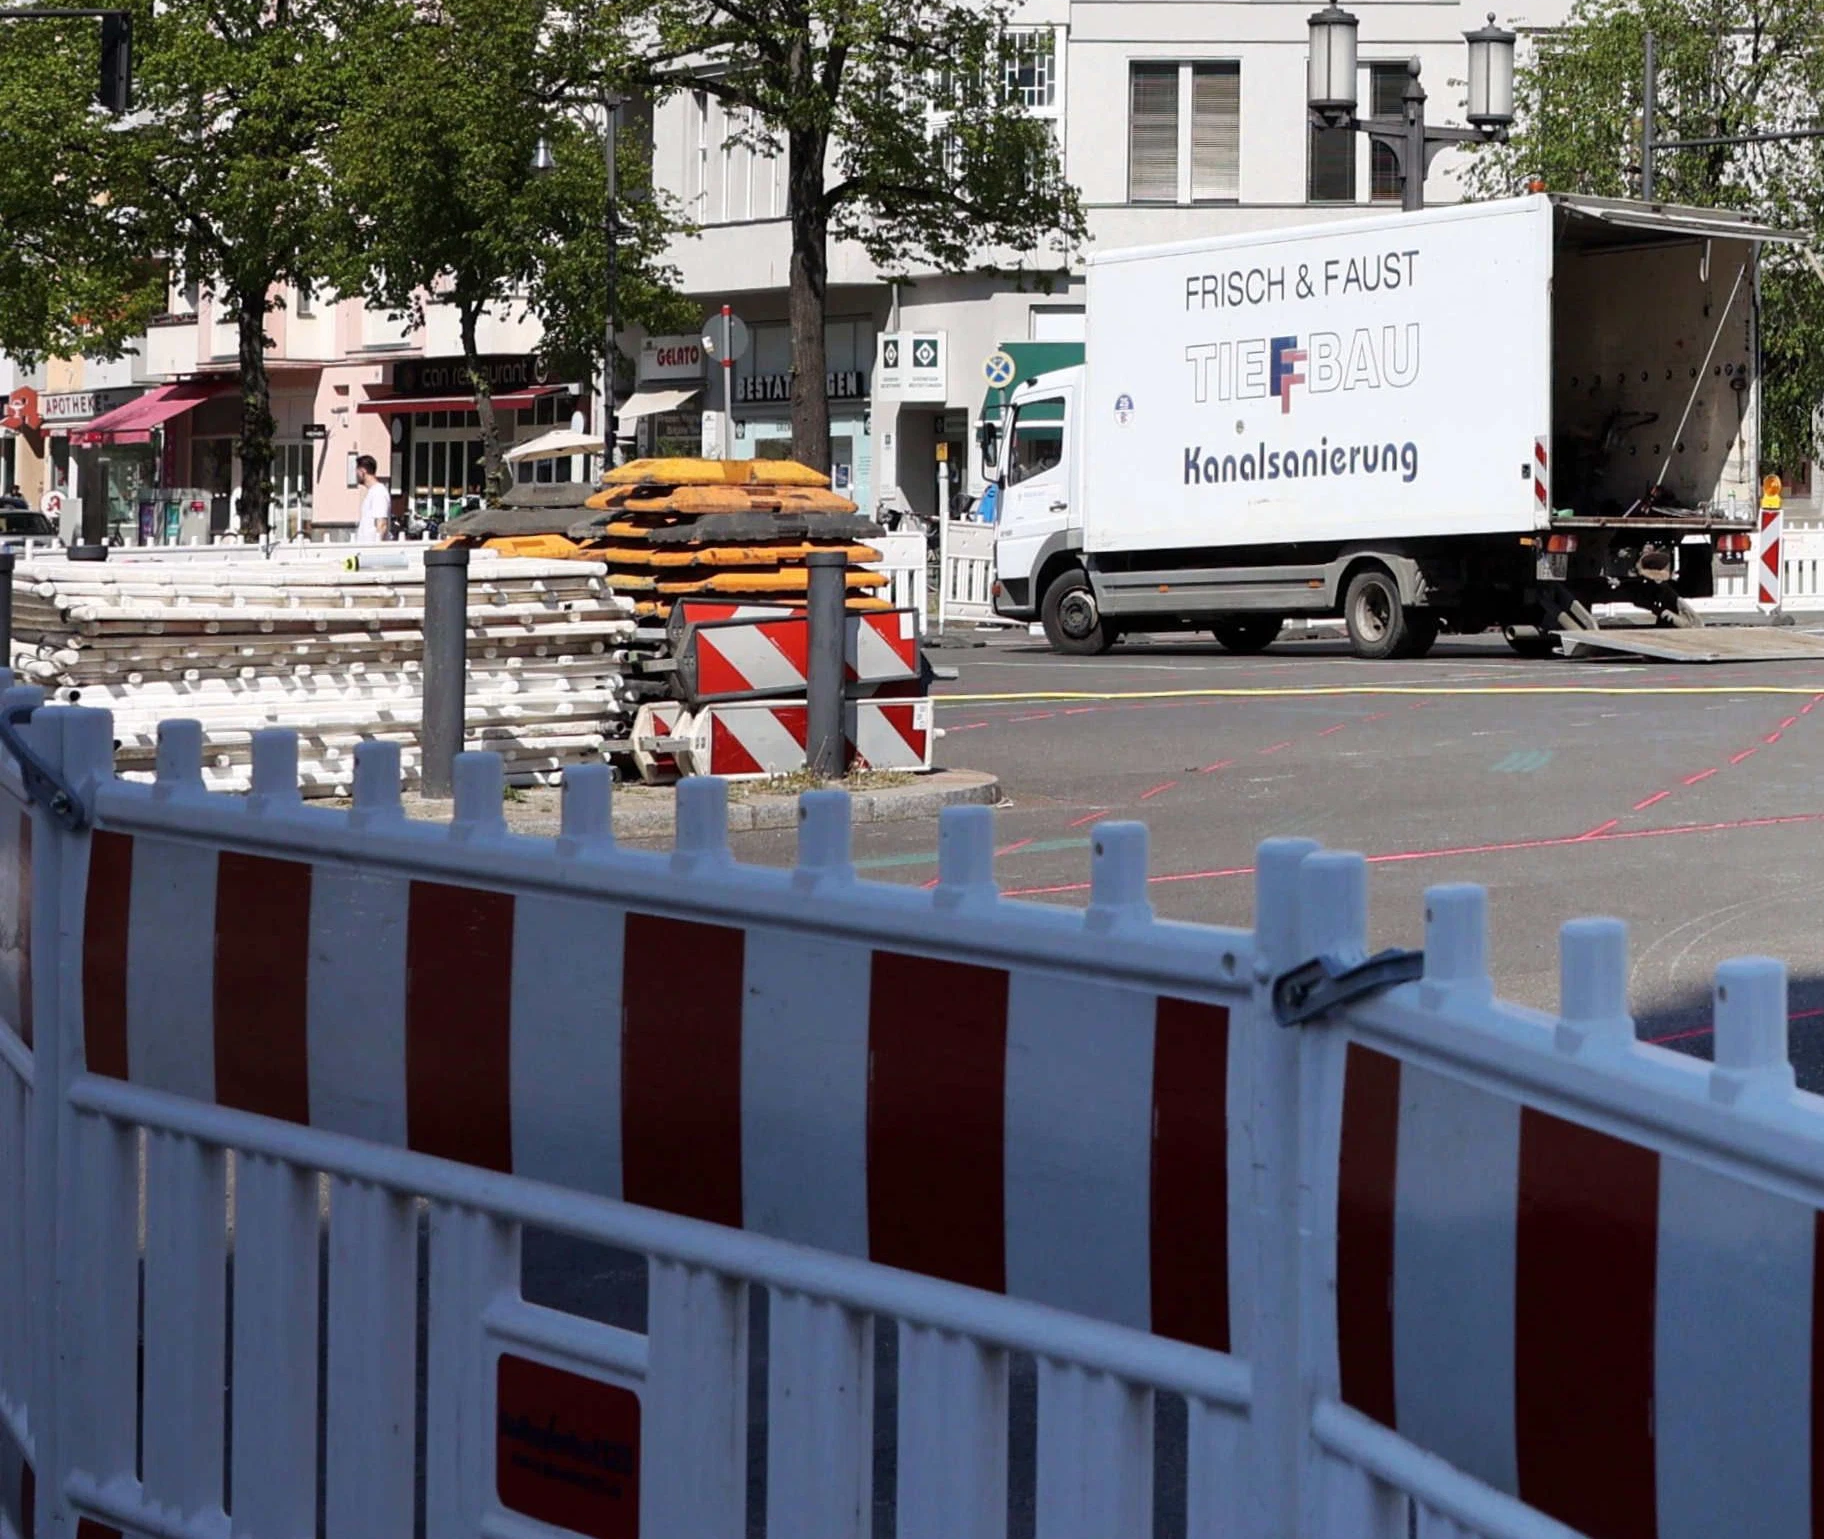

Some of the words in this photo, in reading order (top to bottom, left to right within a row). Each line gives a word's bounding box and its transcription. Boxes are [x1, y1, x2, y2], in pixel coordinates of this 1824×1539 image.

[1185, 266, 1285, 311] FRISCH
[1296, 264, 1316, 299] &
[1324, 250, 1420, 296] FAUST
[656, 345, 699, 366] GELATO
[452, 360, 528, 385] reaurant
[735, 371, 858, 400] BESTATGEN
[46, 394, 101, 416] APOTHEKE
[1183, 436, 1419, 484] Kanalsanierung
